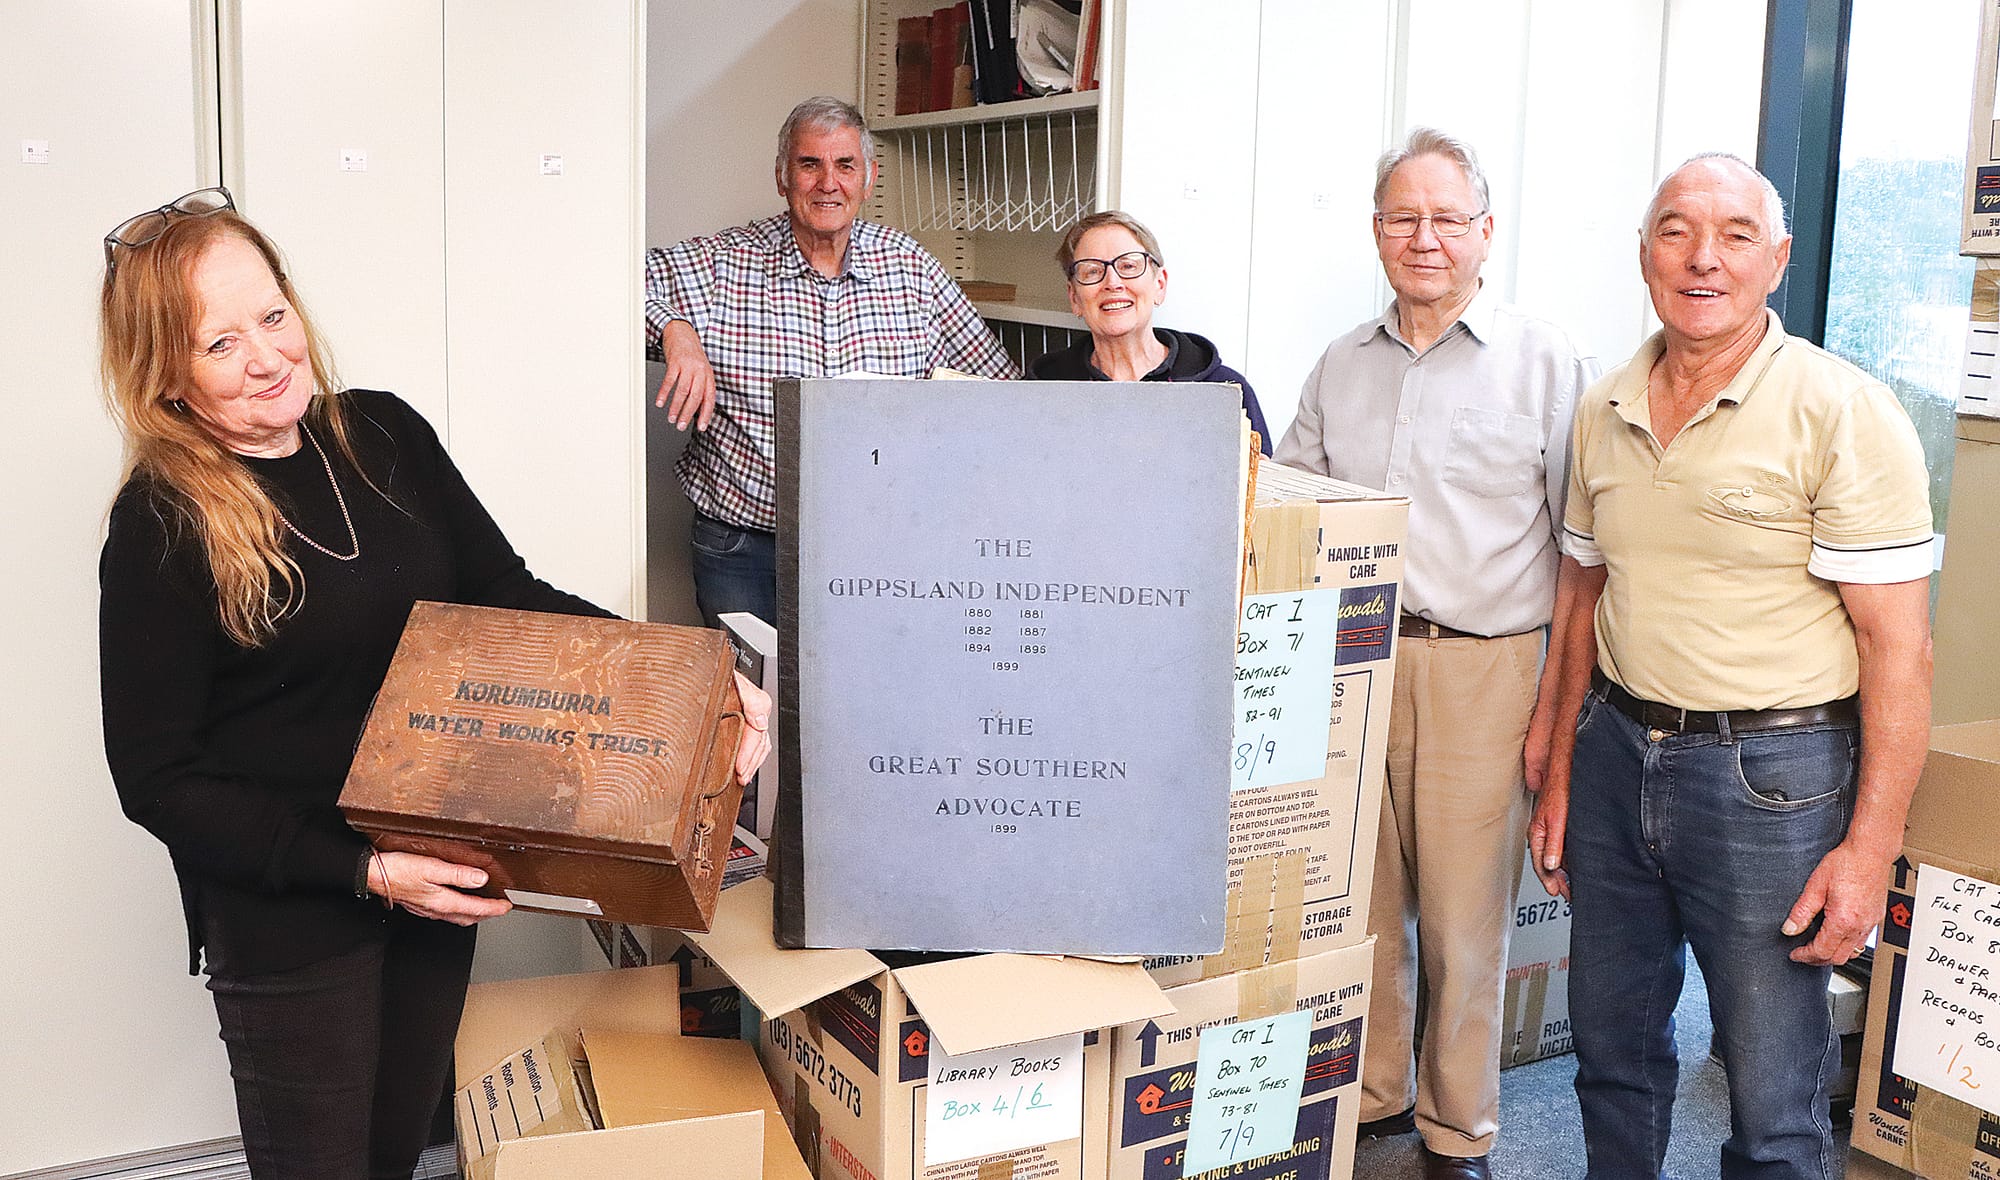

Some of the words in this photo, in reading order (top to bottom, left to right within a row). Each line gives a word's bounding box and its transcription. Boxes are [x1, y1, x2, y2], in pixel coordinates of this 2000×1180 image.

[871, 448, 879, 465] 1
[975, 538, 1032, 558] THE
[1328, 546, 1370, 562] HANDLE
[1373, 543, 1398, 559] WITH
[1350, 563, 1377, 579] CARE
[828, 577, 985, 600] GIPPSLAND
[995, 582, 1191, 607] INDEPENDENT
[964, 608, 992, 618] 1880
[1020, 609, 1044, 619] 1881
[1246, 602, 1278, 620] CAT
[964, 626, 992, 636] 1882
[1020, 627, 1046, 637] 1887
[964, 643, 991, 653] 1894
[992, 662, 1019, 671] 1899
[454, 680, 612, 716] KORUMBURRA
[1243, 685, 1276, 700] TIMES
[408, 712, 484, 737] WATER
[499, 723, 577, 747] WORKS
[587, 732, 670, 757] TRUST.
[978, 717, 1034, 736] THE
[1234, 733, 1276, 781] 8/9
[868, 755, 962, 776] GREAT
[976, 758, 1127, 779] SOUTHERN
[1240, 795, 1272, 808] CARTONS
[1273, 791, 1300, 803] ALWAYS
[1301, 788, 1319, 798] WELL
[935, 798, 1081, 818] ADVOCATE
[1245, 809, 1256, 818] ON
[1257, 805, 1285, 817] BOTTOM
[1286, 802, 1300, 812] AND
[990, 824, 1017, 834] 1899
[1236, 819, 1269, 832] CARTONS
[1270, 816, 1290, 827] LINED
[1291, 812, 1307, 823] WITH
[1236, 833, 1250, 842] THE
[1252, 831, 1264, 840] TOP
[1265, 829, 1276, 838] OR
[1277, 827, 1291, 836] PAD
[1292, 824, 1308, 833] WITH
[1309, 820, 1330, 831] PAPER
[1237, 844, 1252, 853] NOT
[1322, 874, 1331, 883] AT
[1953, 878, 1986, 898] CAT
[1305, 905, 1352, 925] STORAGE
[1516, 900, 1558, 927] 5672
[1926, 946, 1990, 981] DRAWER
[1296, 990, 1336, 1012] HANDLE
[1338, 982, 1363, 1001] WITH
[1969, 982, 2000, 1006] PAR
[1315, 1004, 1343, 1022] CARE
[1921, 989, 1984, 1025] RECORDS
[1166, 1026, 1192, 1044] THIS
[1232, 1028, 1256, 1044] CAT
[522, 1048, 543, 1094] Destination
[769, 1018, 792, 1061] (03)
[795, 1034, 825, 1087] 5672
[829, 1063, 862, 1118] 3773
[936, 1064, 999, 1085] LIBRARY
[1010, 1057, 1062, 1077] BOOKS
[1249, 1055, 1268, 1073] 70
[501, 1061, 515, 1088] Room
[482, 1074, 499, 1111] Contents
[1258, 1077, 1290, 1093] TIMES
[1221, 1102, 1258, 1118] 73-81
[1172, 1115, 1182, 1127] &
[1218, 1119, 1255, 1160] 7/9
[926, 1168, 945, 1177] CHINA
[945, 1164, 960, 1173] INTO
[960, 1160, 980, 1169] LARGE
[1008, 1148, 1031, 1158] ALWAYS
[1031, 1145, 1047, 1154] WELL
[1019, 1157, 1032, 1165] AND
[1024, 1164, 1039, 1173] WITH
[1041, 1168, 1060, 1178] PAPER
